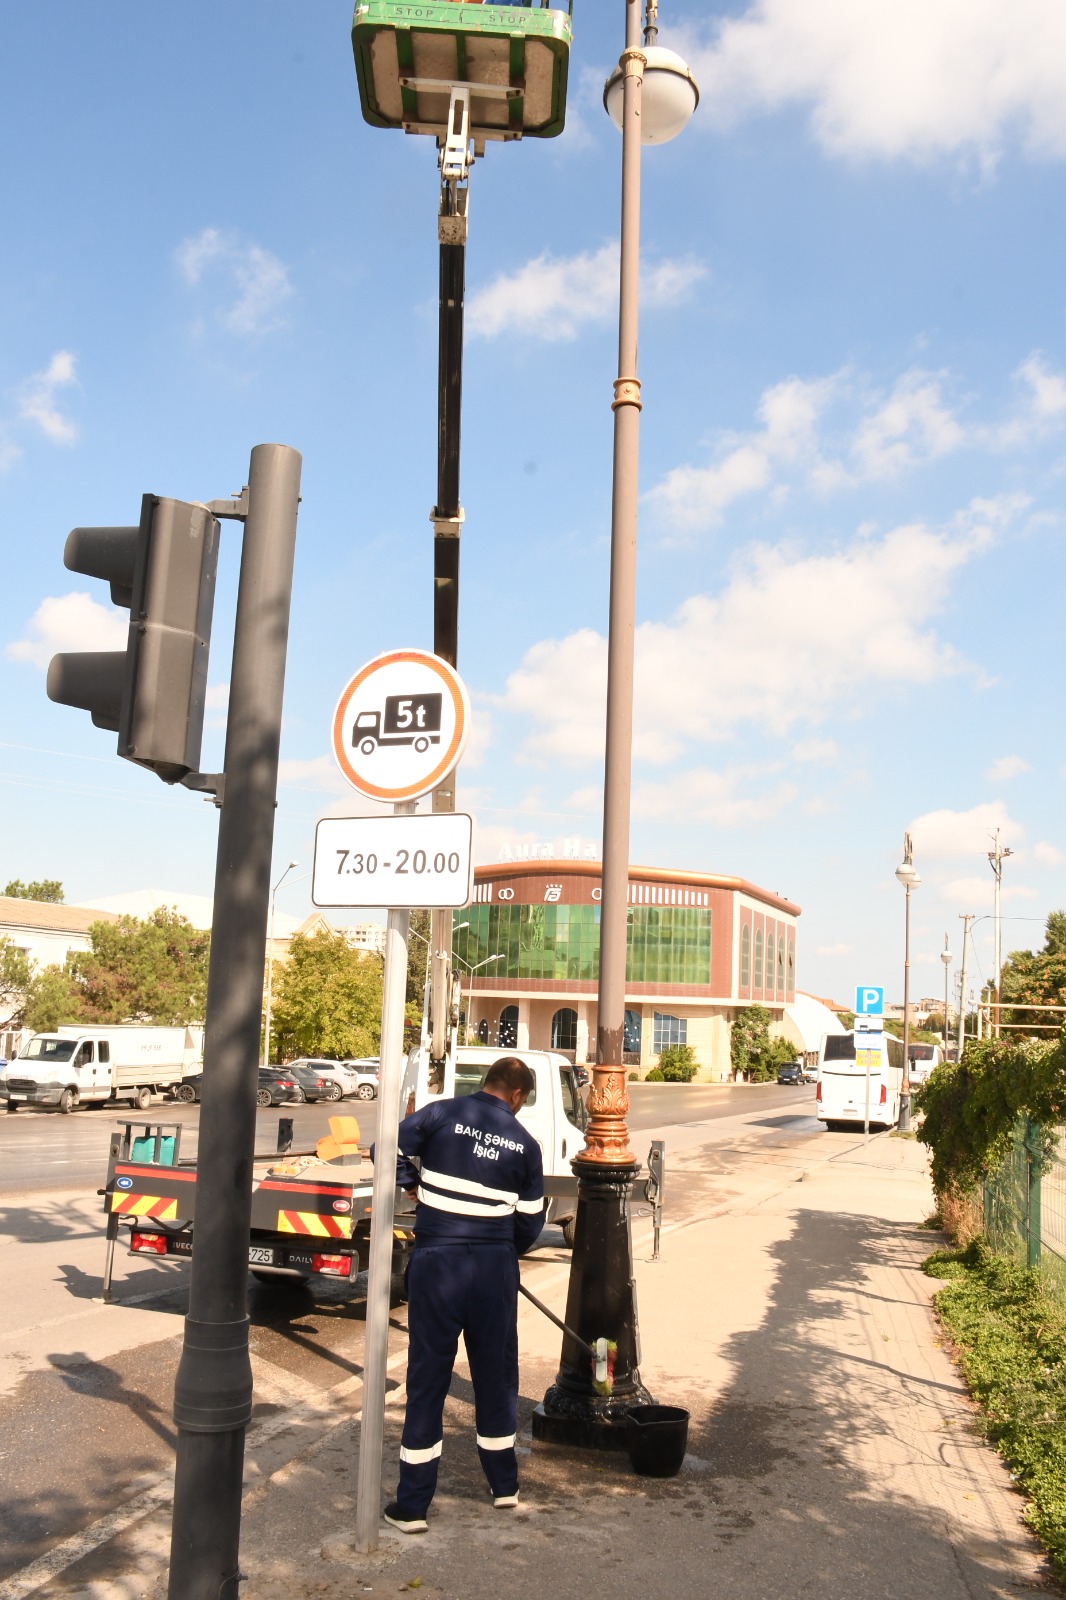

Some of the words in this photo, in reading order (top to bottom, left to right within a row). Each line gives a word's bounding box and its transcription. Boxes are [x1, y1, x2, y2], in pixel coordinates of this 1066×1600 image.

[395, 7, 434, 18] STOP
[489, 14, 526, 24] STOP
[397, 701, 426, 728] 5t
[497, 842, 554, 860] Aura
[862, 989, 880, 1011] P
[455, 1124, 482, 1140] BAKI
